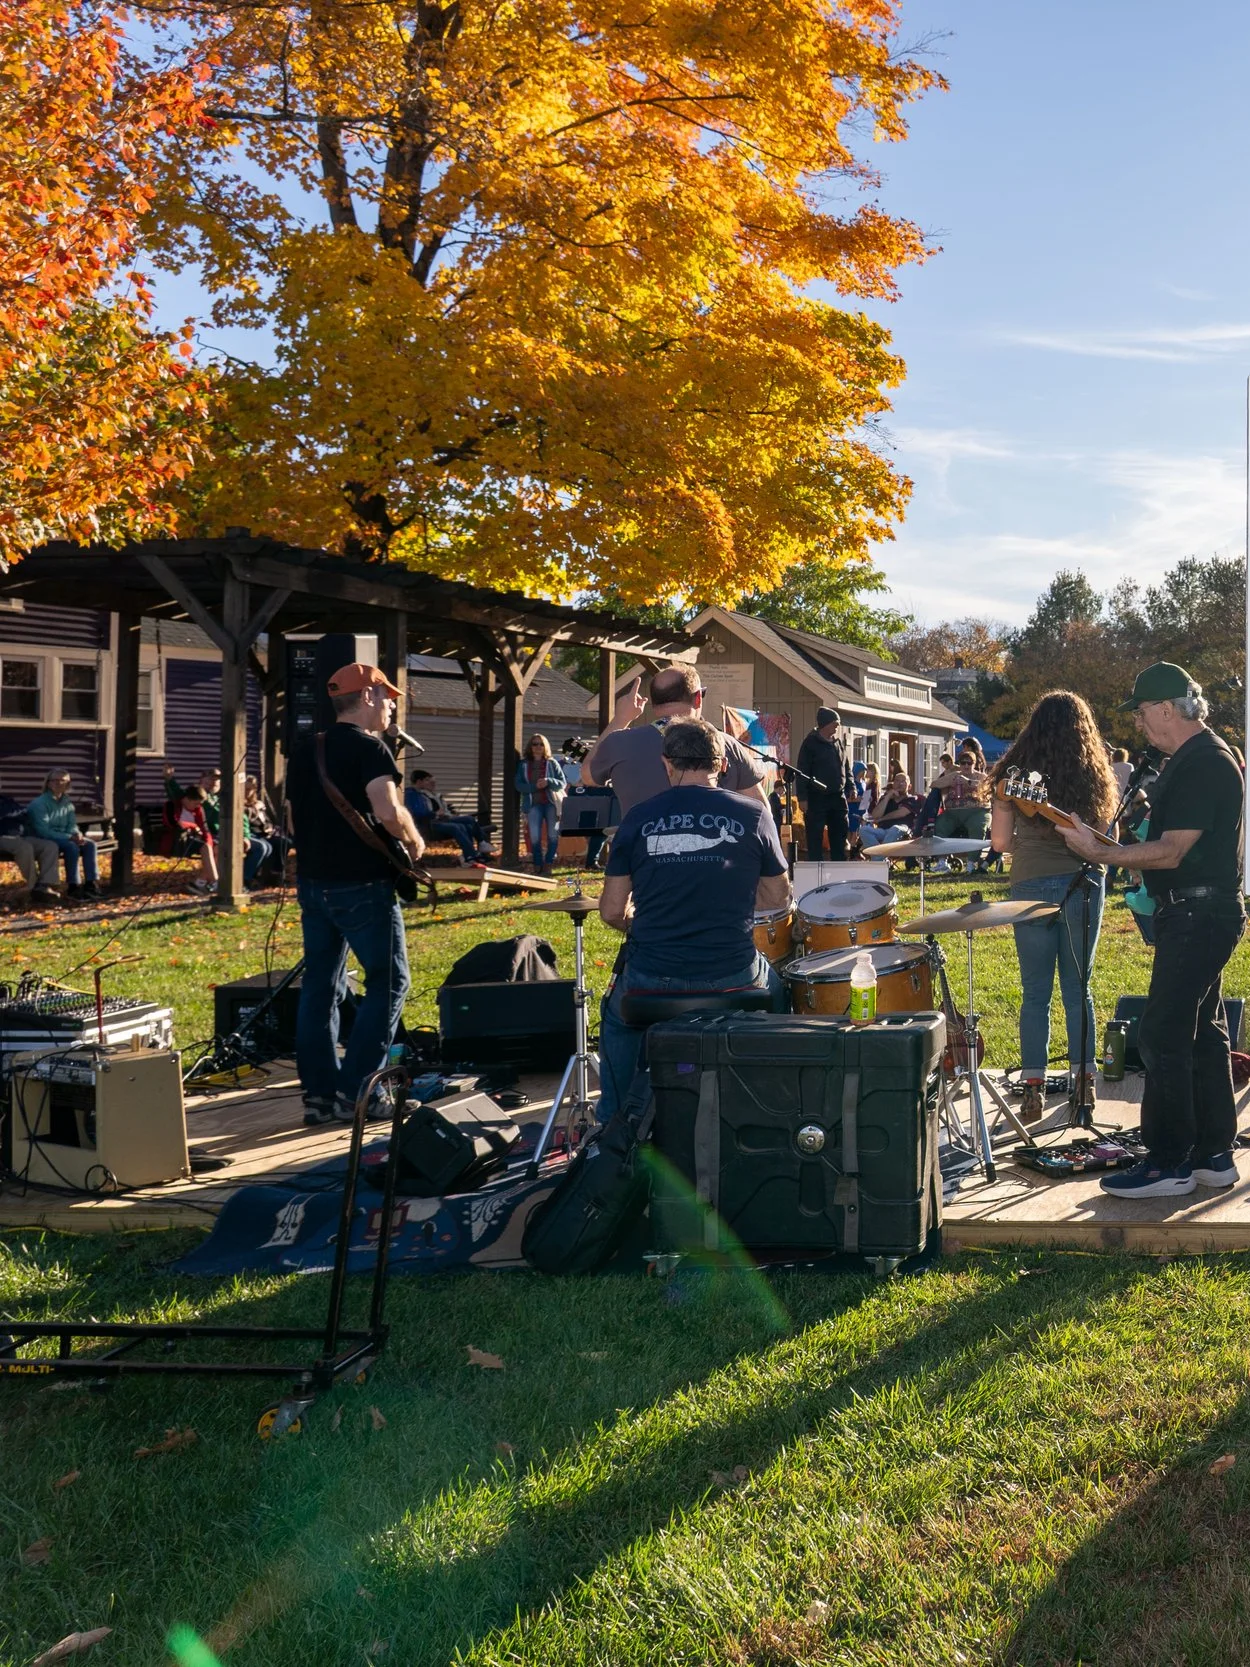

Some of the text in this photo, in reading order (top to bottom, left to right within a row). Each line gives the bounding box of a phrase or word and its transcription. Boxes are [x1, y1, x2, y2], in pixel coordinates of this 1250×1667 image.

[641, 814, 745, 837] CAPE COD
[655, 855, 726, 864] MASSACHUSETTS
